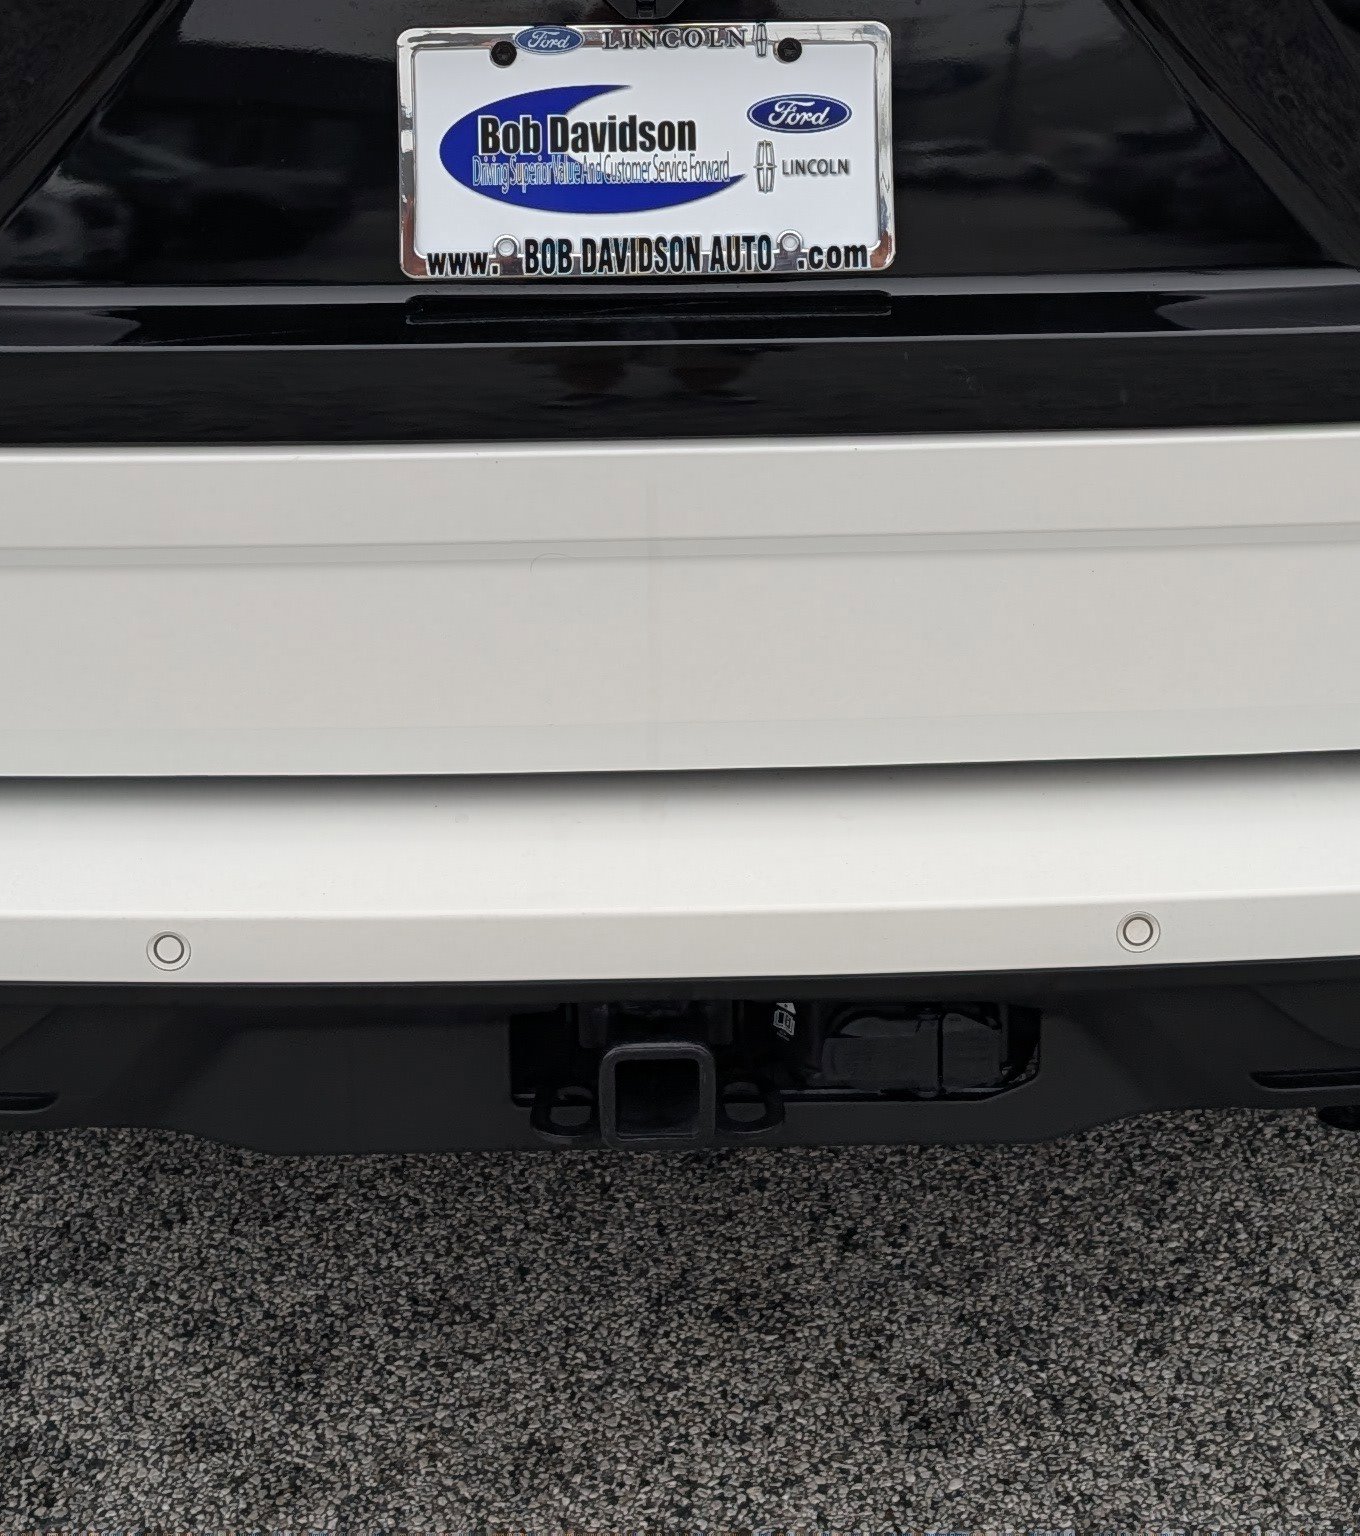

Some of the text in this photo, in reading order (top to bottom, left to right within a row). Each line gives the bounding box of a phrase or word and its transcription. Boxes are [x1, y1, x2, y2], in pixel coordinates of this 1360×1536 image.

[528, 28, 571, 50] Ford
[602, 28, 746, 50] LINCOLN
[768, 99, 830, 127] Ford
[481, 115, 697, 154] Bob Davidson
[473, 151, 730, 194] Driving Superior Value And Customer Service Forward
[782, 158, 849, 176] LINCOLN
[427, 235, 869, 275] www. BOB DAVIDSON AUTO .com
